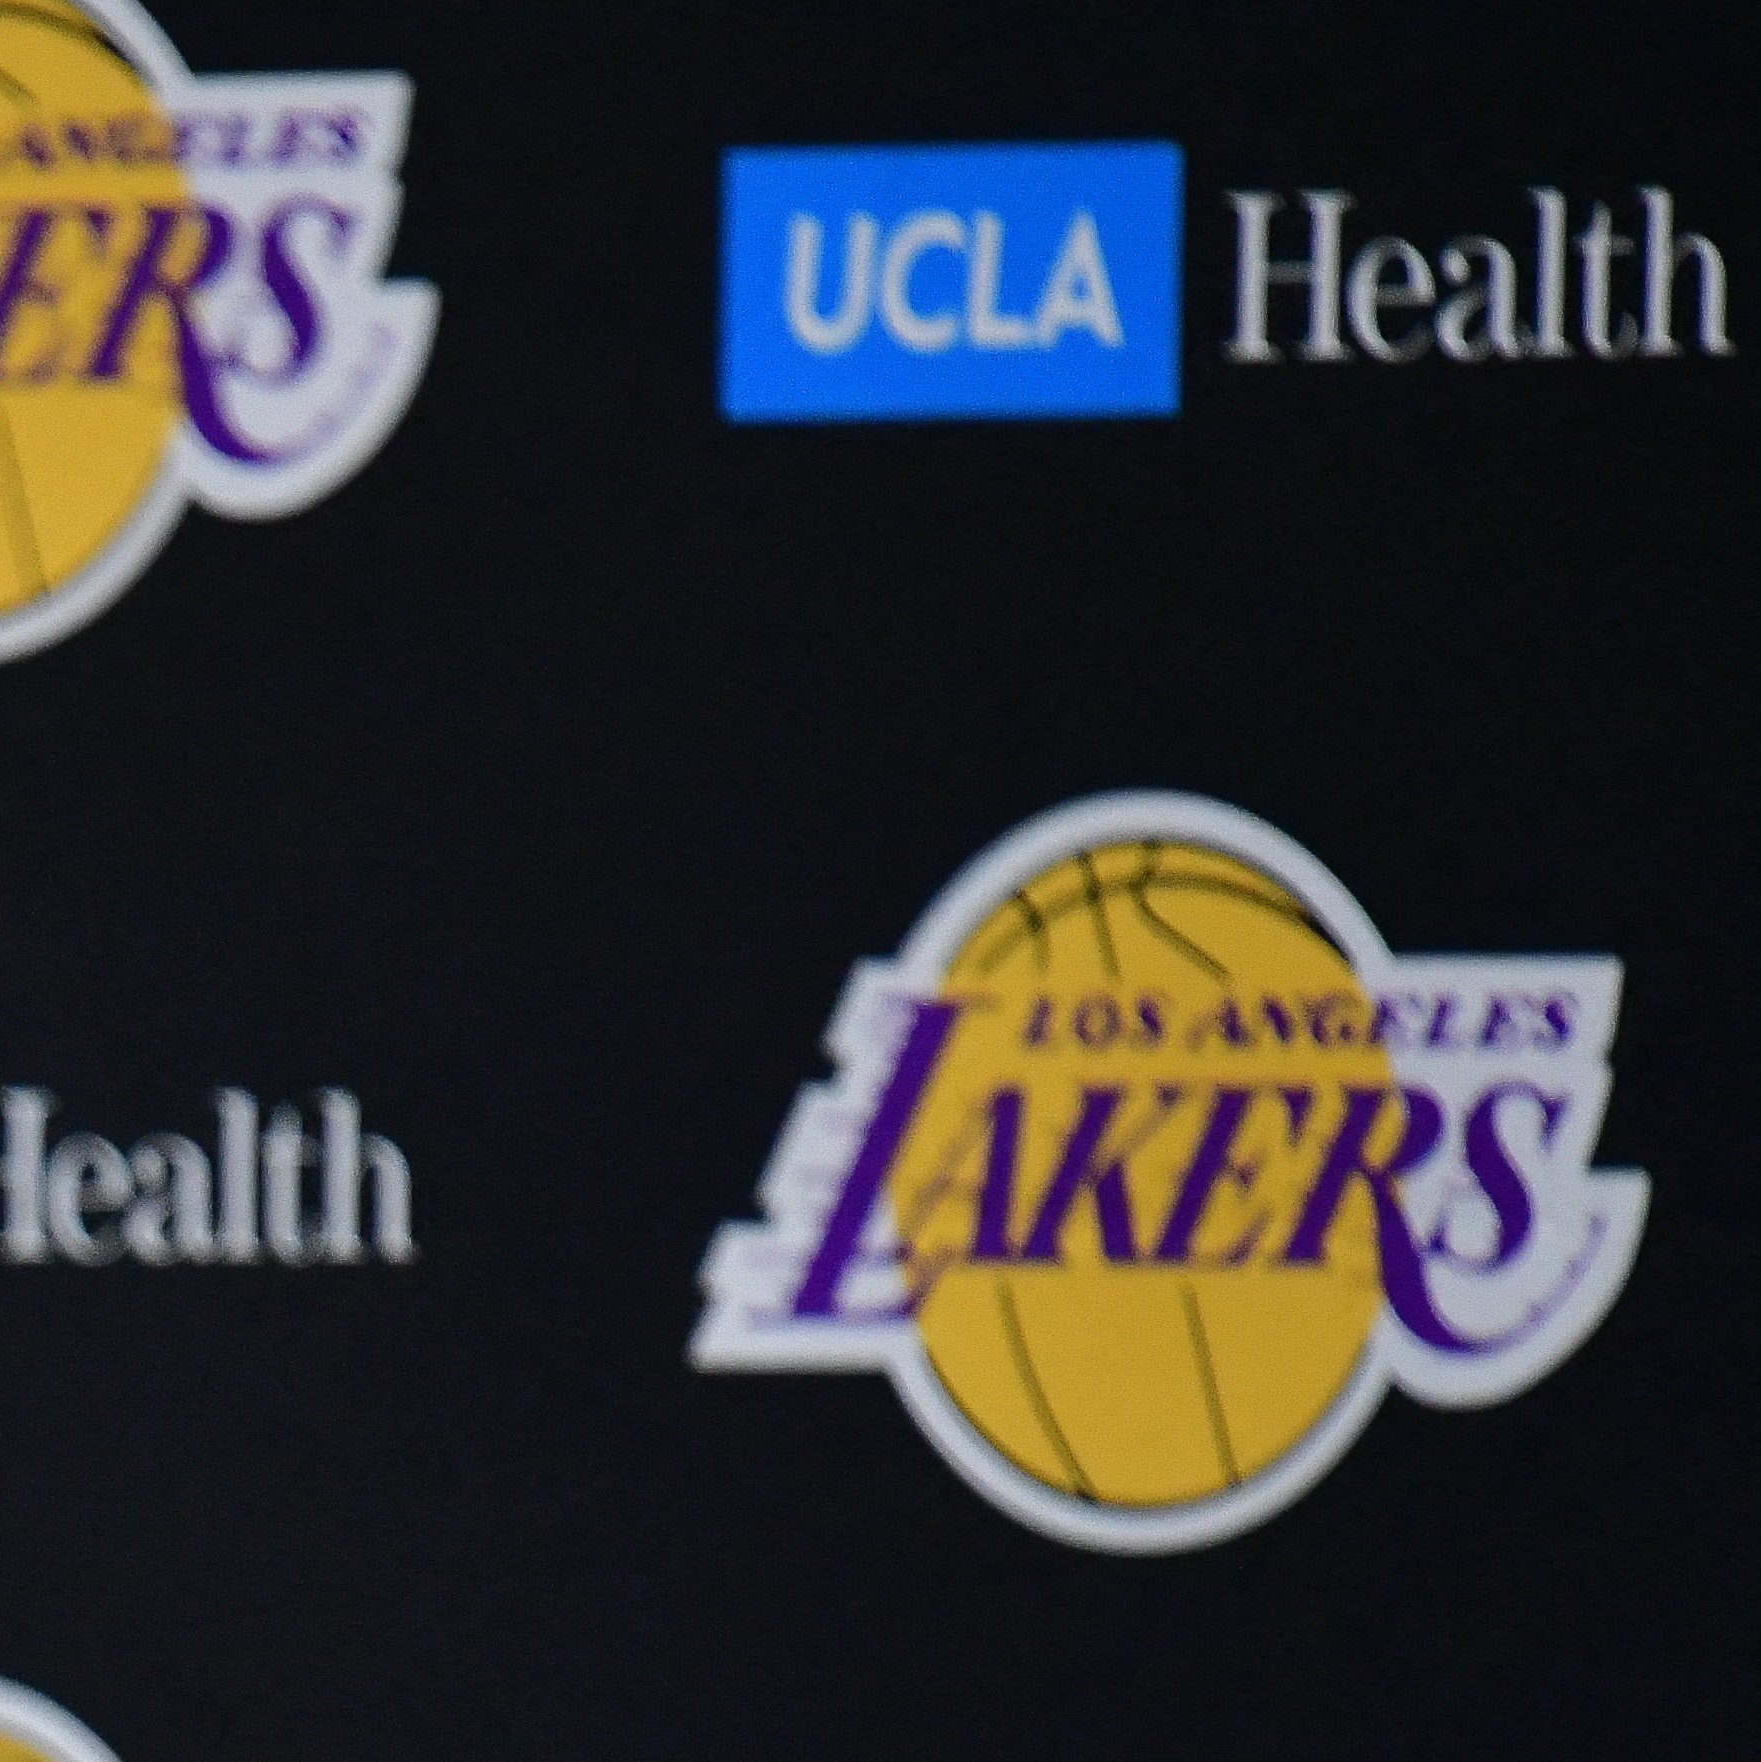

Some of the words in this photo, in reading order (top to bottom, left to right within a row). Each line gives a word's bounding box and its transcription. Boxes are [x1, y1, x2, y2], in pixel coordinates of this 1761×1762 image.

[9, 106, 367, 168] ANGELES
[782, 206, 1127, 357] UCLA
[1222, 184, 1739, 363] Health
[1024, 990, 1168, 1049] LOS
[1186, 988, 1583, 1049] ANGELES
[747, 993, 1607, 1358] LAKERS
